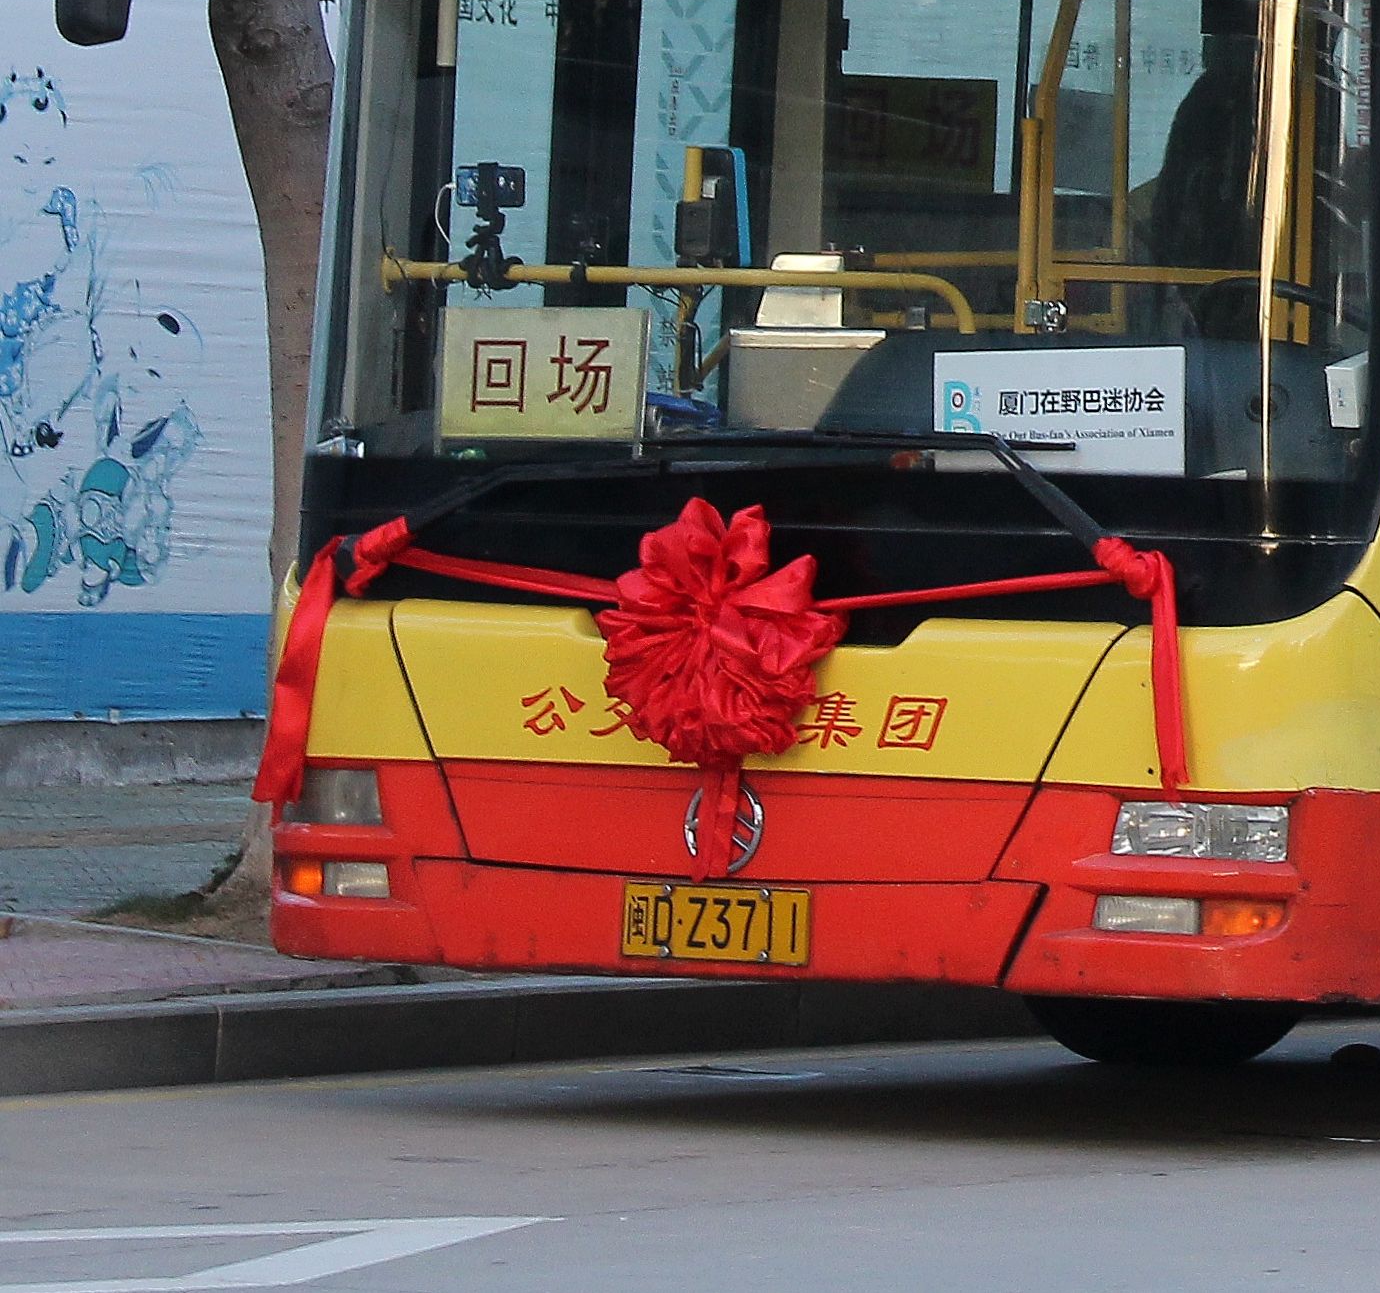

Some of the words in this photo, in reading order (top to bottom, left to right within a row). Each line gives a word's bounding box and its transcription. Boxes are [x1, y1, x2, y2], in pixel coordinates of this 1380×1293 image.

[470, 334, 612, 414] 回场
[999, 388, 1165, 416] 厦门在野巴迷协会
